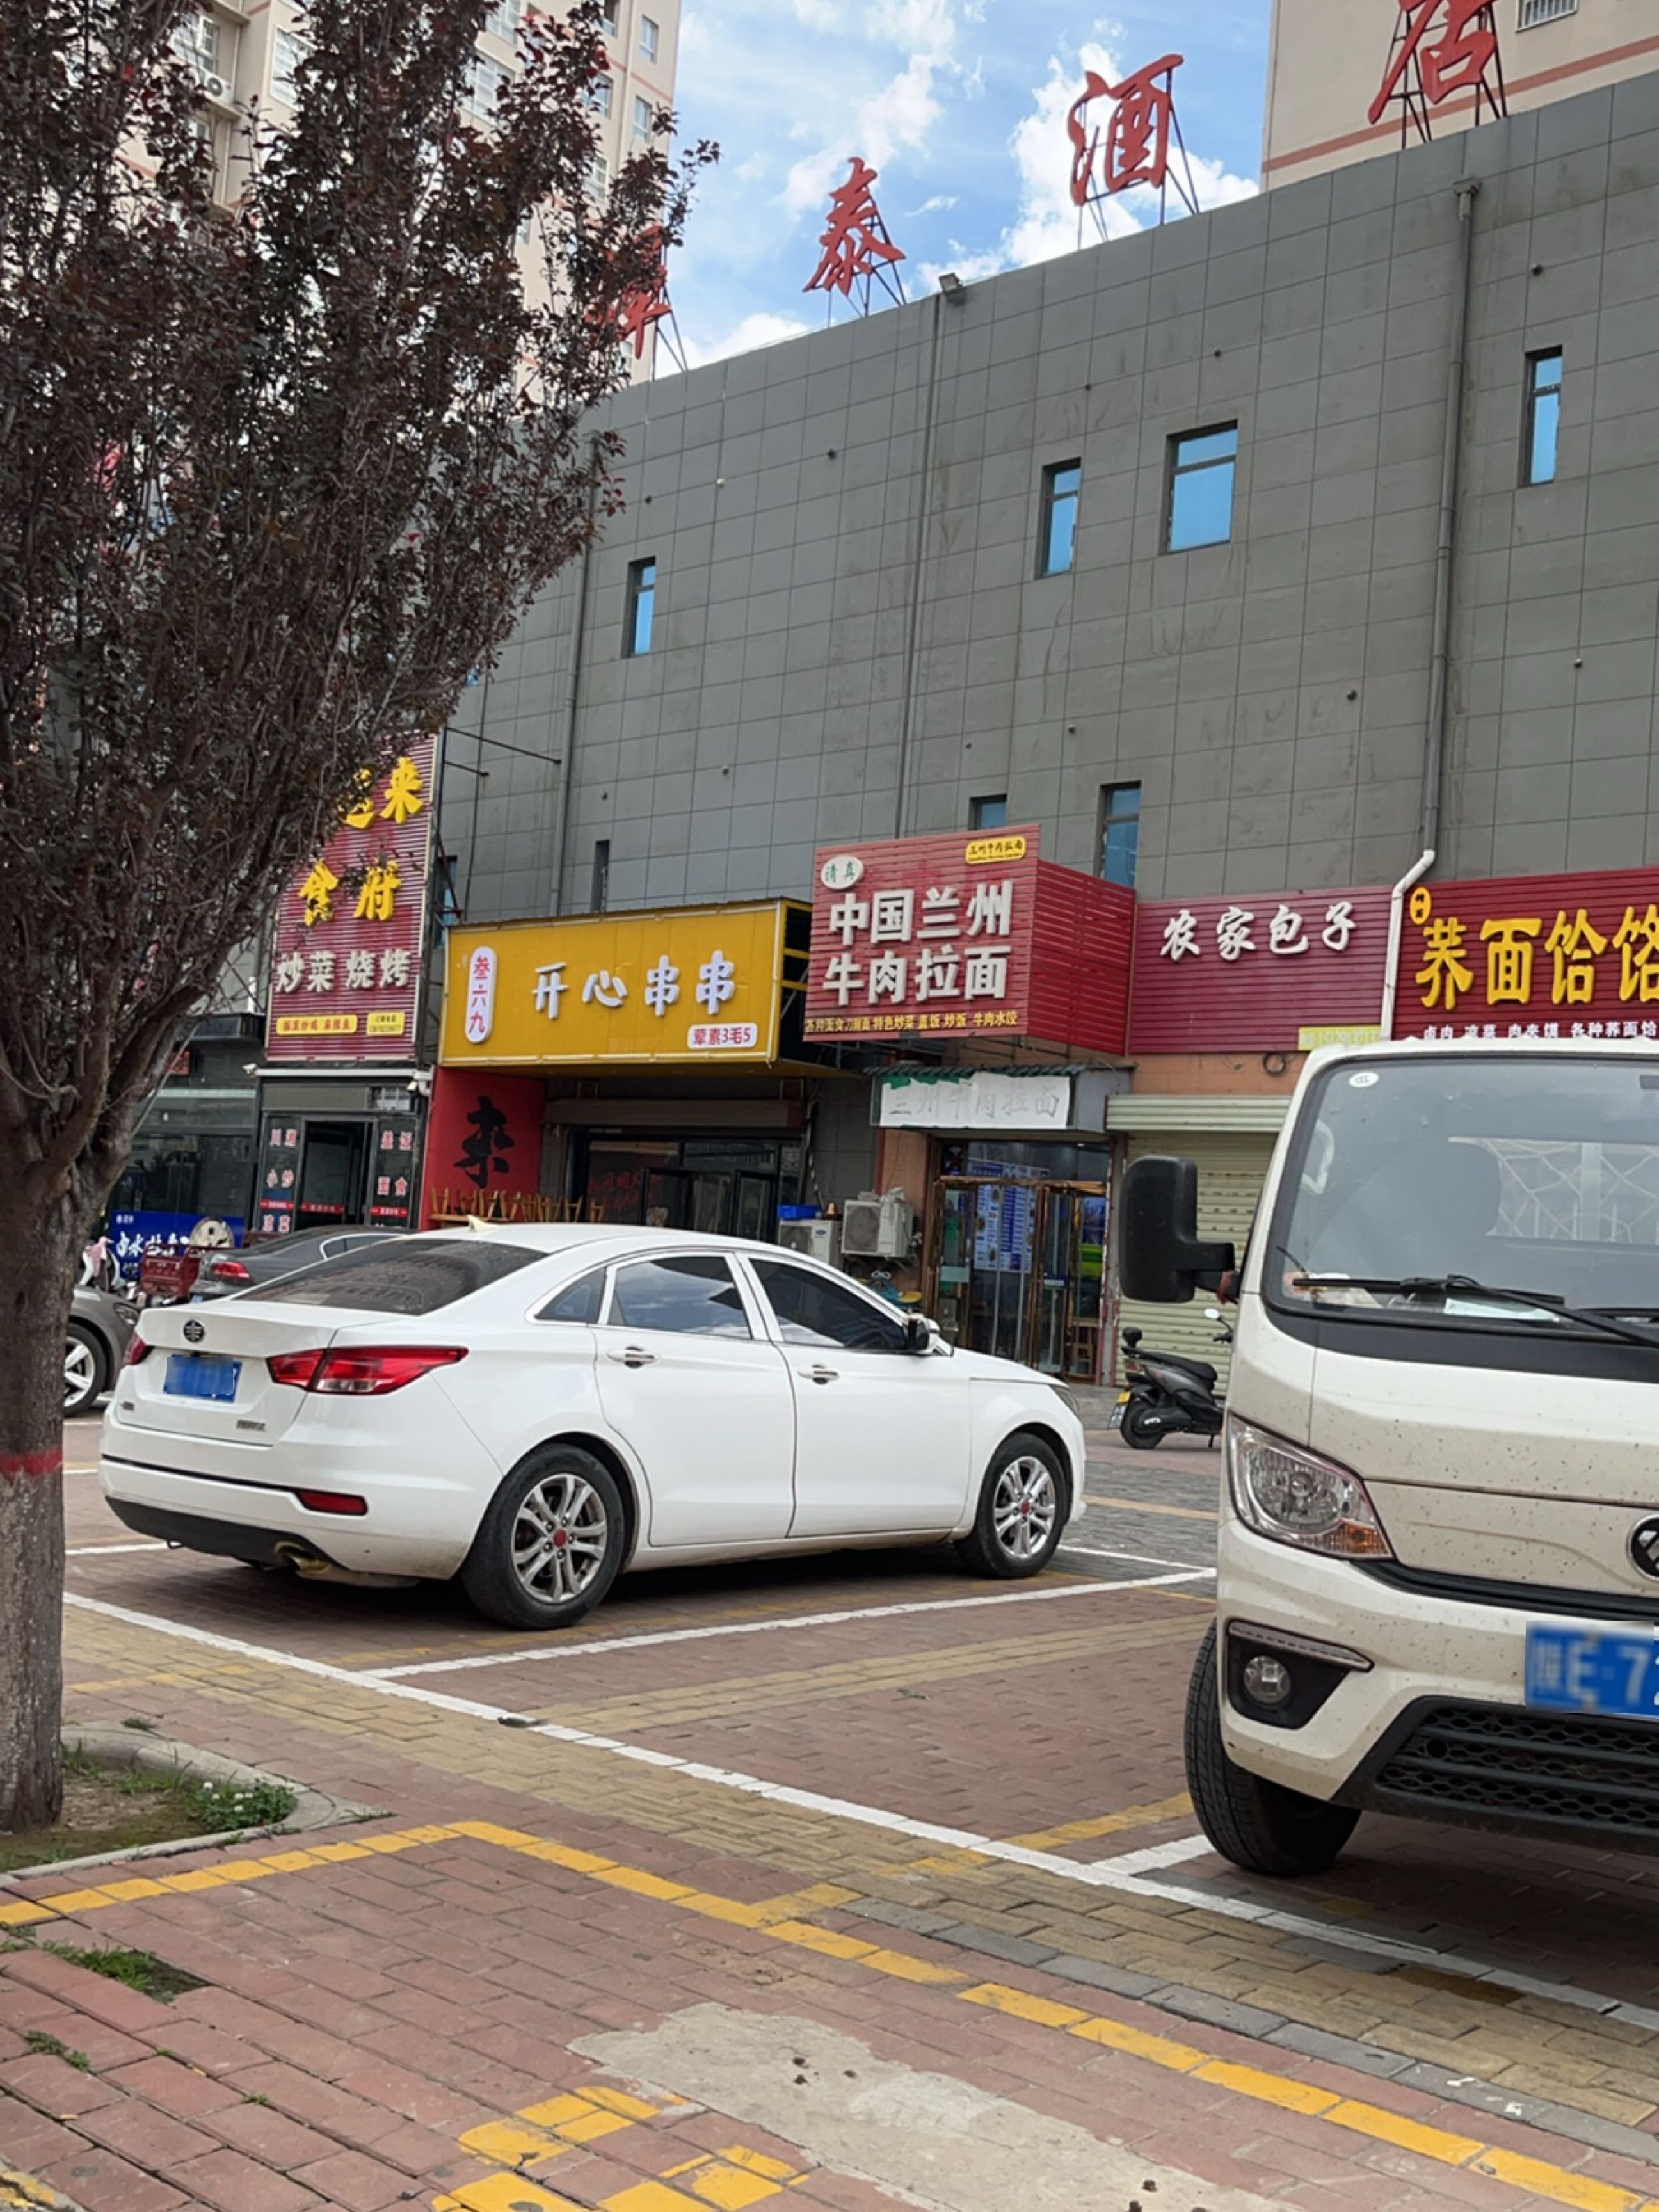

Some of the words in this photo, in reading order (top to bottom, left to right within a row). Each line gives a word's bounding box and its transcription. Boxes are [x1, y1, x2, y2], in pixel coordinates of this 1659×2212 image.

[298, 860, 402, 926] 食府
[825, 861, 856, 882] 清真
[830, 879, 1013, 945] 中国兰州
[1160, 901, 1356, 961] 农家包子
[276, 951, 335, 992] 炒菜
[346, 949, 411, 988] 烧烤
[532, 950, 735, 1020] 开心串串
[822, 944, 1012, 1006] 牛肉拉面
[1415, 904, 1659, 1010] 荞面饸饹
[693, 1027, 752, 1044] 荤素3毛5
